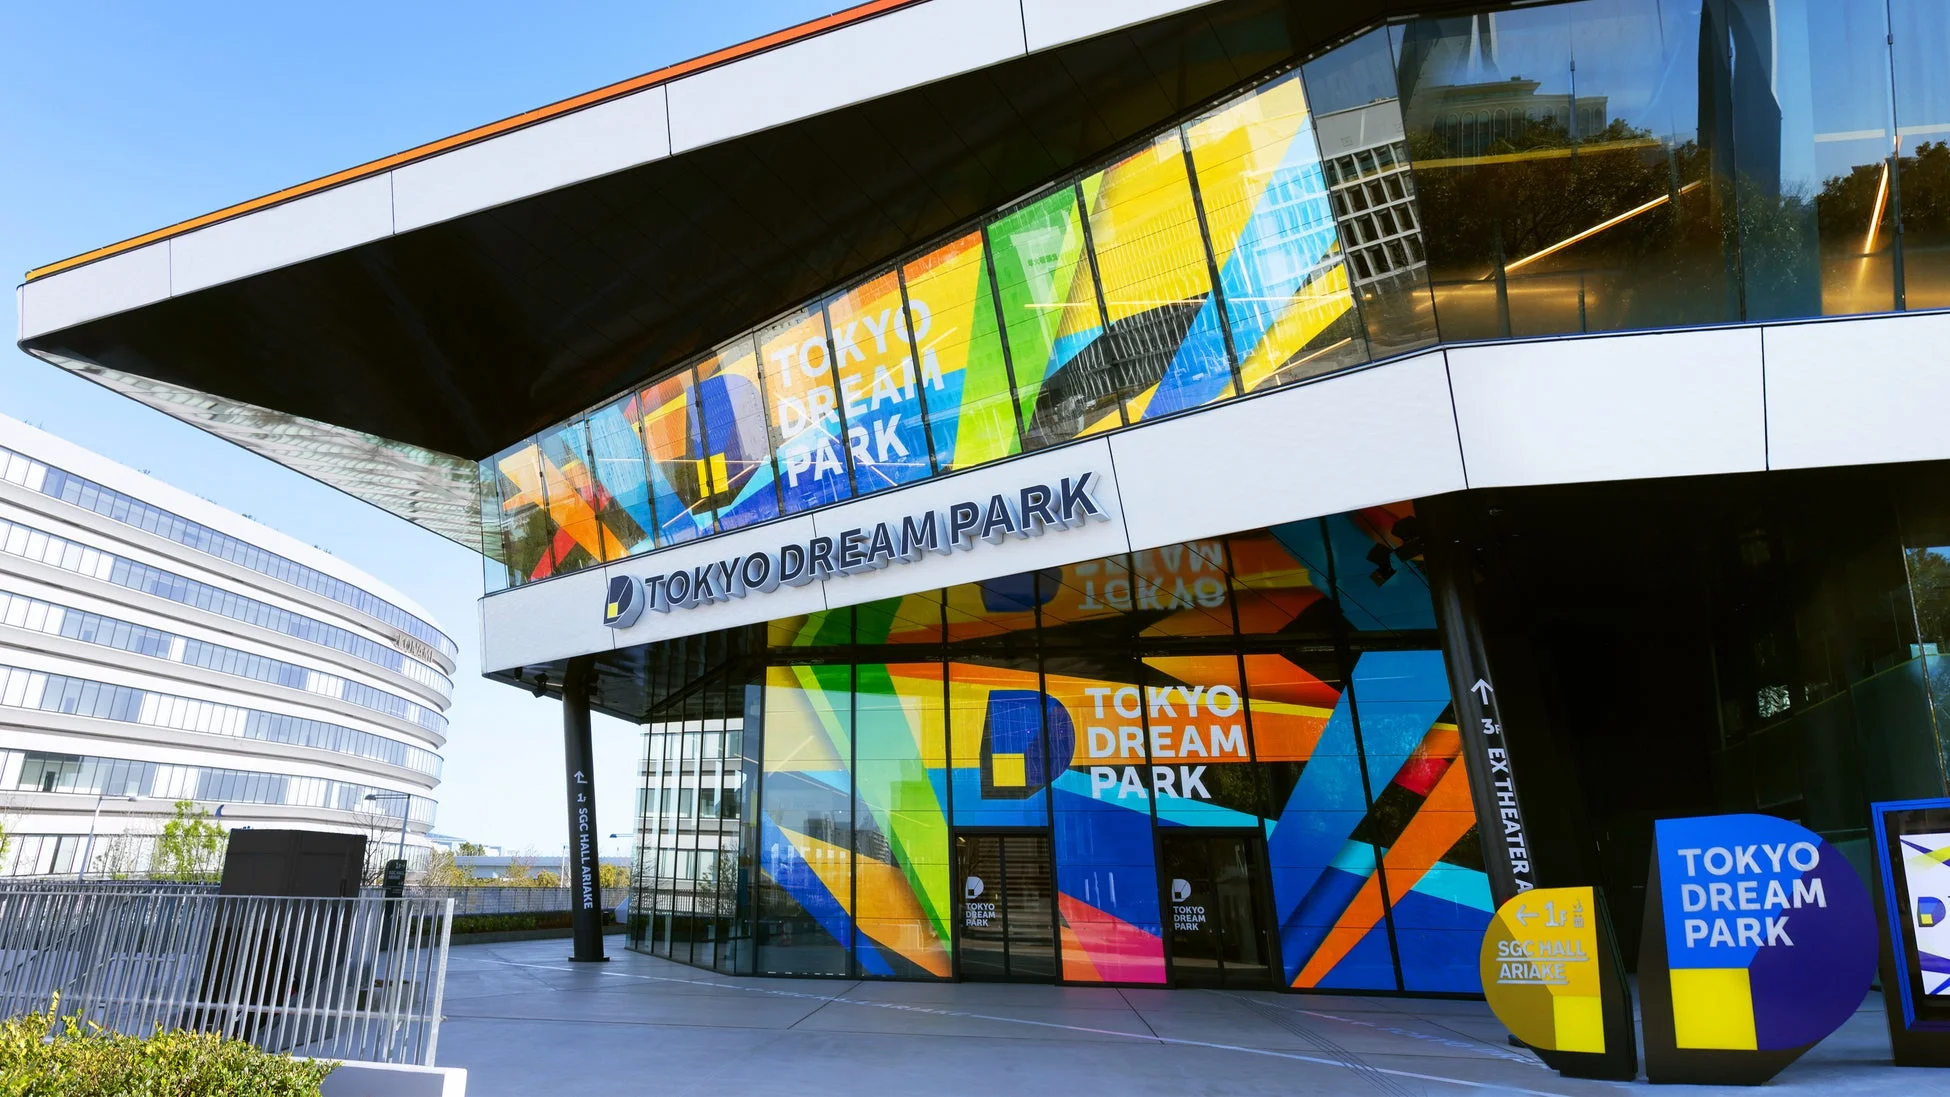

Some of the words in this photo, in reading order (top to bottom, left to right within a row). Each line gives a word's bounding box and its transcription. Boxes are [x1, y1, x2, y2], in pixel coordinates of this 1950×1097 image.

[771, 299, 931, 388] TOKYO
[778, 348, 945, 439] DREAM
[785, 413, 910, 488] PARK
[644, 551, 770, 609] TOKYO
[779, 510, 938, 582] DREAM
[950, 471, 1100, 545] PARK
[1084, 684, 1239, 719] TOKYO
[1087, 725, 1247, 758] DREAM
[1488, 748, 1510, 773] EX
[1090, 765, 1211, 799] PARK
[578, 807, 588, 831] SGC
[1494, 778, 1529, 875] THEATER
[580, 834, 590, 865] HALL
[1677, 841, 1820, 877] TOKYO
[582, 866, 593, 909] ARIAKE
[1680, 878, 1827, 912] DREAM
[965, 902, 995, 911] TOKYO
[965, 911, 996, 919] DREAM
[1173, 905, 1205, 914] TOKYO
[1173, 914, 1206, 922] DREAM
[1544, 901, 1567, 927] 1F
[965, 918, 989, 927] PARK
[1174, 922, 1200, 931] PARK
[1684, 916, 1794, 948] PARK
[1497, 940, 1534, 957] SGC
[1538, 940, 1586, 957] HALL
[1499, 963, 1566, 979] ARIAKE
